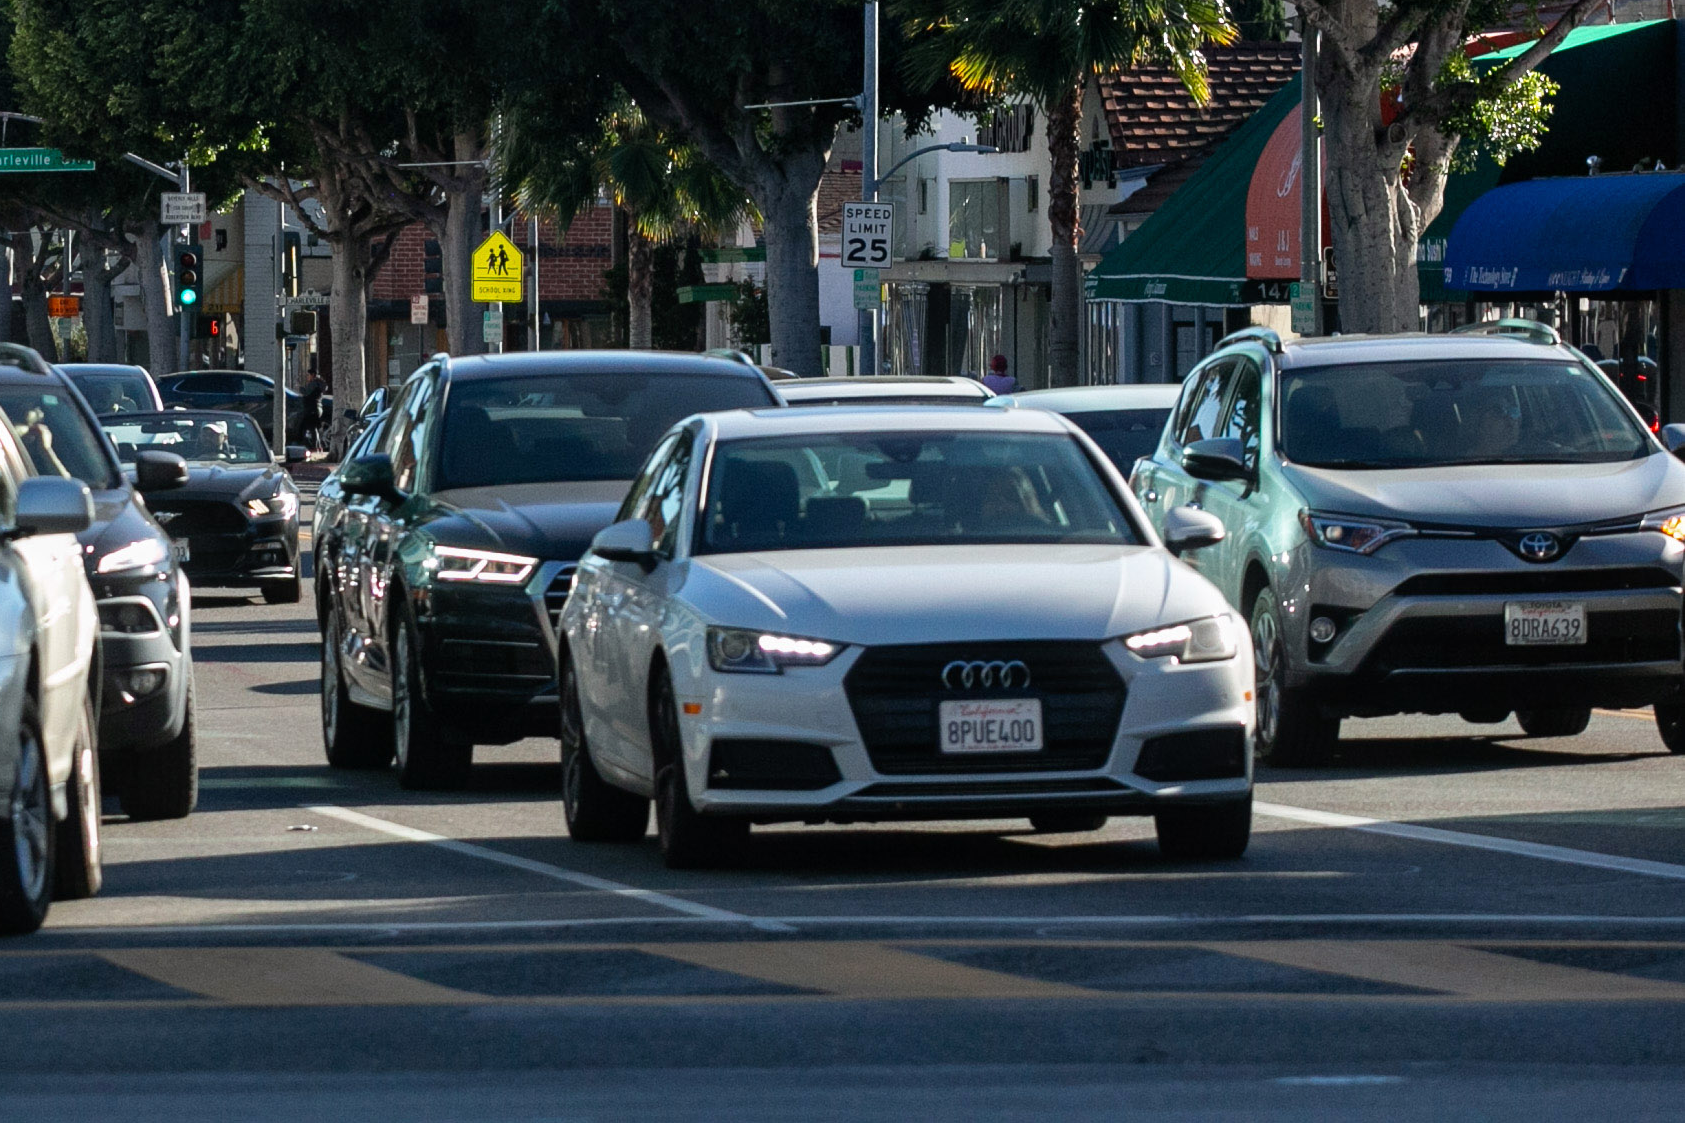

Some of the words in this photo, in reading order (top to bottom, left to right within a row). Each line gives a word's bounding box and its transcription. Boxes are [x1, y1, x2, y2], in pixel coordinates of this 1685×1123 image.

[846, 207, 891, 220] SPEED
[849, 222, 887, 234] LIMIT
[846, 237, 888, 263] 25
[1469, 266, 1478, 283] The
[478, 286, 501, 294] SCHOOL
[1292, 284, 1299, 297] 2
[287, 295, 324, 305] CHARLEVILLE
[210, 320, 219, 336] 6
[1529, 601, 1563, 609] TOYOTA
[1511, 618, 1581, 638] 8DRA639
[947, 719, 1035, 745] 8PUE400
